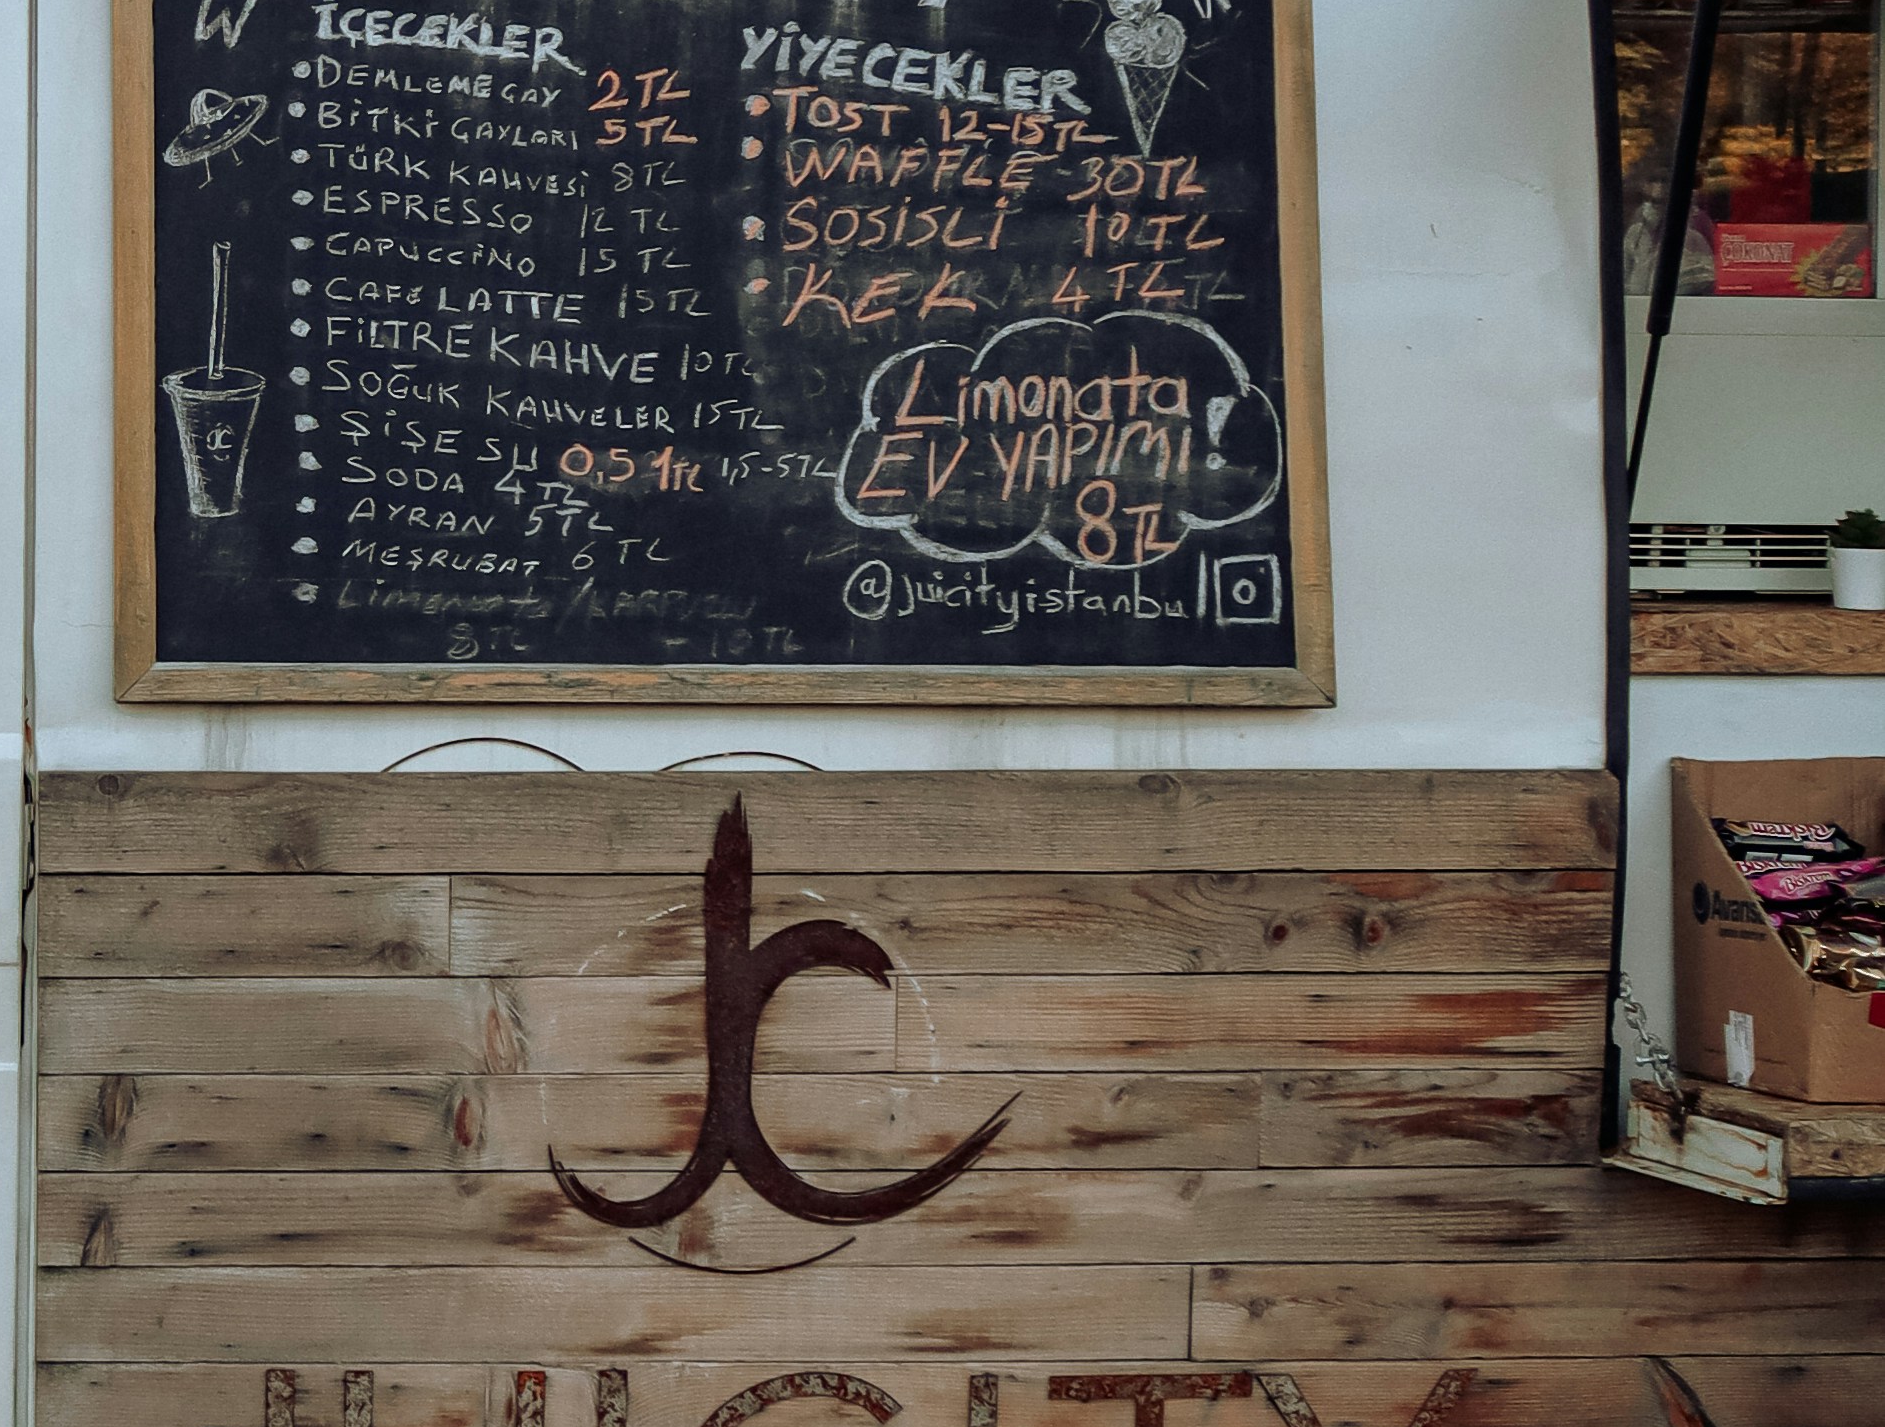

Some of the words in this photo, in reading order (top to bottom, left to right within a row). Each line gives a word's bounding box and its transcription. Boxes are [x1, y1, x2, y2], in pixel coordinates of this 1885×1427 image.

[317, 54, 493, 99] DEMLEME
[588, 67, 629, 112] 2
[634, 67, 691, 110] TL
[740, 20, 1092, 114] YİYECEKLER
[317, 98, 436, 139] BİTKİ
[595, 118, 628, 146] 5
[634, 115, 699, 148] TL
[773, 85, 910, 138] TOST
[317, 142, 431, 181] TÜRK
[449, 159, 590, 198] KAHVESİ
[612, 162, 634, 192] 8
[642, 160, 687, 188] TL
[784, 143, 1060, 193] WAFFLE
[322, 184, 534, 235] ESPRESSO
[580, 203, 615, 239] 12
[630, 207, 682, 233] TL
[782, 195, 1009, 253] SOSİSLİ
[1078, 202, 1132, 259] 10
[1144, 213, 1226, 252] TL
[578, 246, 618, 276] 15
[637, 246, 692, 274] TL
[437, 285, 586, 324] LATTE
[782, 261, 978, 329] KEK
[1052, 266, 1091, 313] 4
[1107, 259, 1187, 303] TL
[326, 315, 474, 359] FİLTRE
[489, 325, 660, 384] KAHVE
[486, 384, 677, 434] KAHVELER
[894, 344, 1192, 428] Limonata
[341, 455, 466, 494] SODA
[857, 429, 970, 502] EV
[347, 496, 497, 537] AYRAN
[1075, 478, 1119, 563] 8
[1121, 502, 1180, 566] TL
[571, 540, 597, 571] 6
[618, 537, 672, 565] TL
